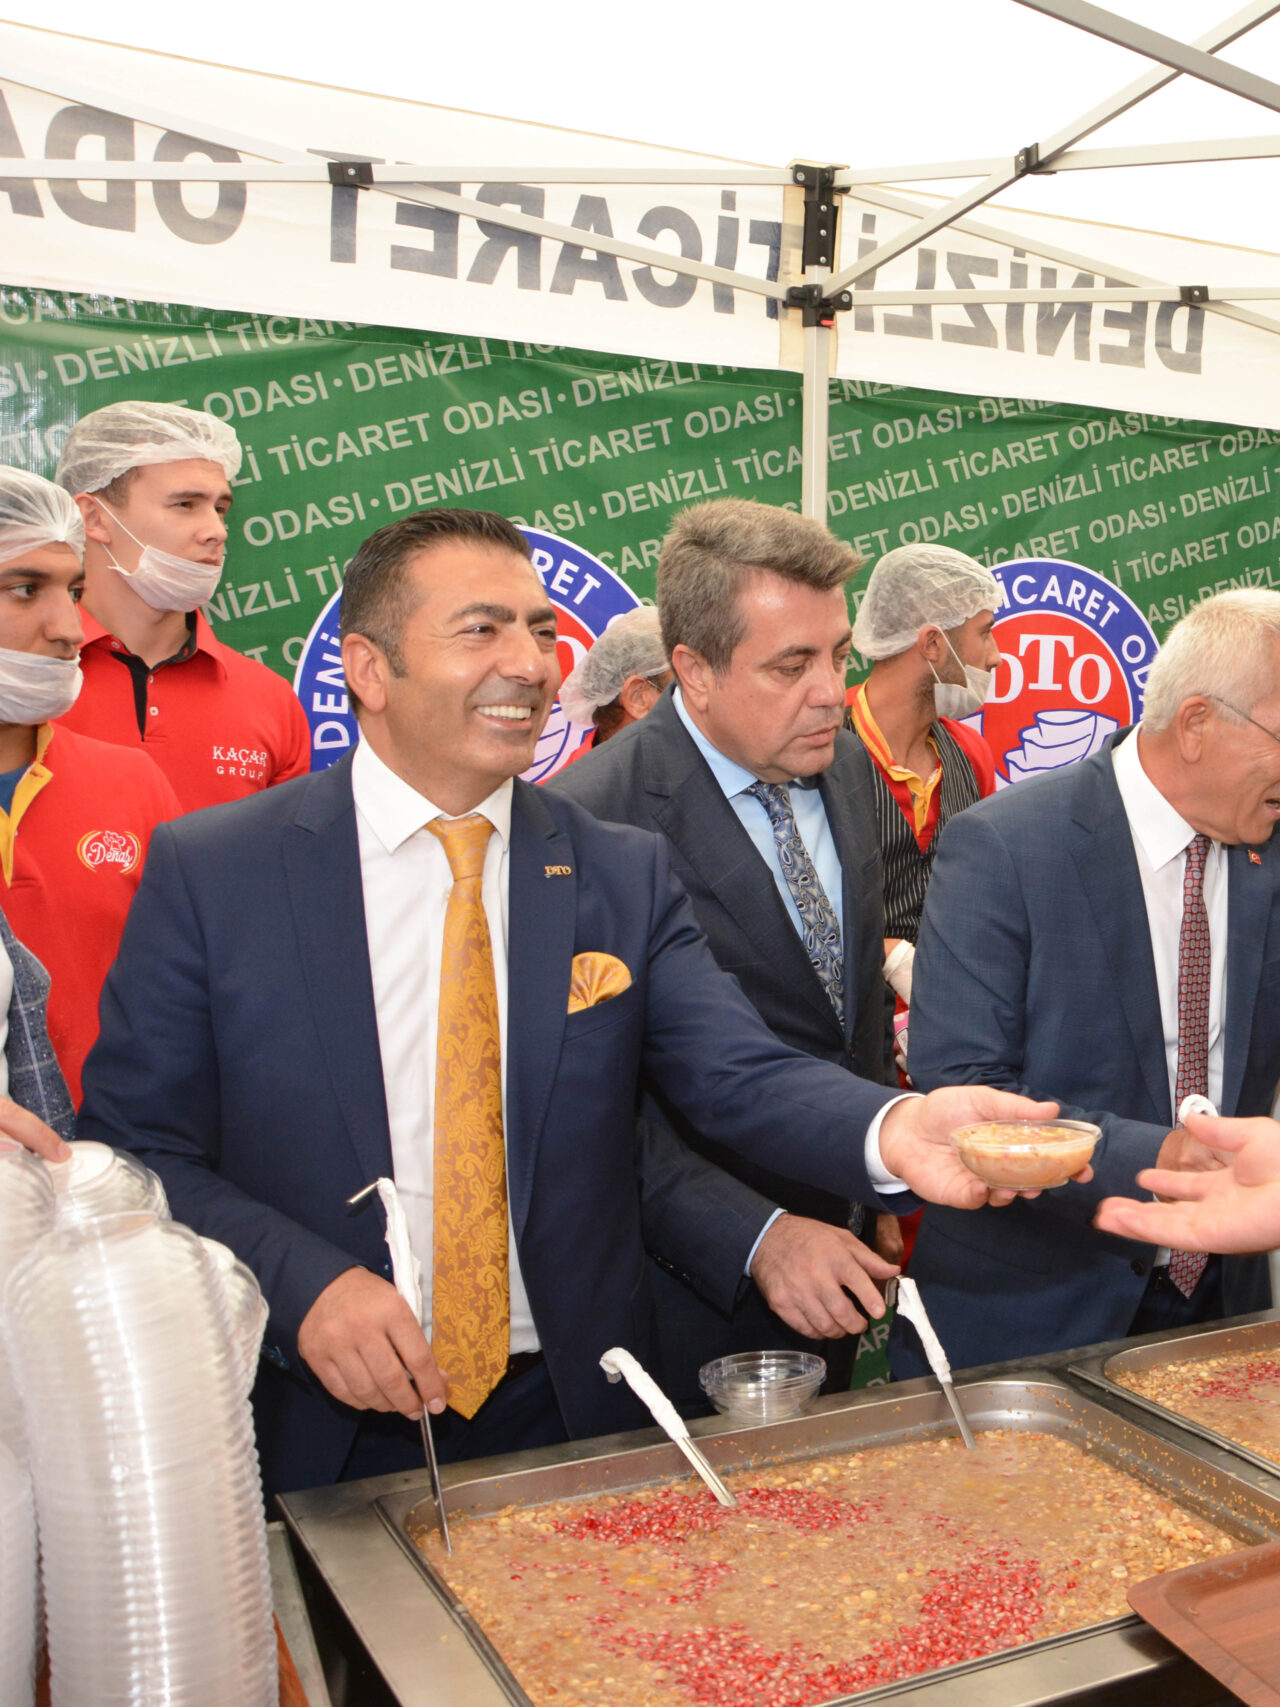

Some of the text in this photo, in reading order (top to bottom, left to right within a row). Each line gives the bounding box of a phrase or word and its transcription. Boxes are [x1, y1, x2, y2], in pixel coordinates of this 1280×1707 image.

[54, 322, 223, 387] DENİZLİ
[203, 371, 330, 423] ODASI
[267, 412, 431, 476] TİCARET
[443, 386, 553, 435] ODASI
[243, 492, 367, 547] ODASI
[384, 446, 526, 513] DENİZLİ
[529, 417, 673, 476] TİCARET
[684, 391, 784, 439] ODASI
[602, 457, 728, 520] DENİZLİ
[872, 405, 963, 449] ODASI
[827, 458, 940, 517] DENİZLİ
[942, 431, 1060, 484] TİCARET
[1067, 412, 1149, 450] ODASI
[899, 501, 989, 546] ODASI
[1002, 463, 1103, 520] DENİZLİ
[1106, 440, 1212, 488] TİCARET
[1088, 501, 1168, 544] ODASI
[1179, 466, 1271, 518] DENİZLİ
[1126, 532, 1230, 583] TİCARET
[993, 572, 1120, 629] İCARET
[984, 633, 1112, 705] DTO
[212, 745, 268, 768] KAÇAR
[216, 765, 264, 781] GROUP
